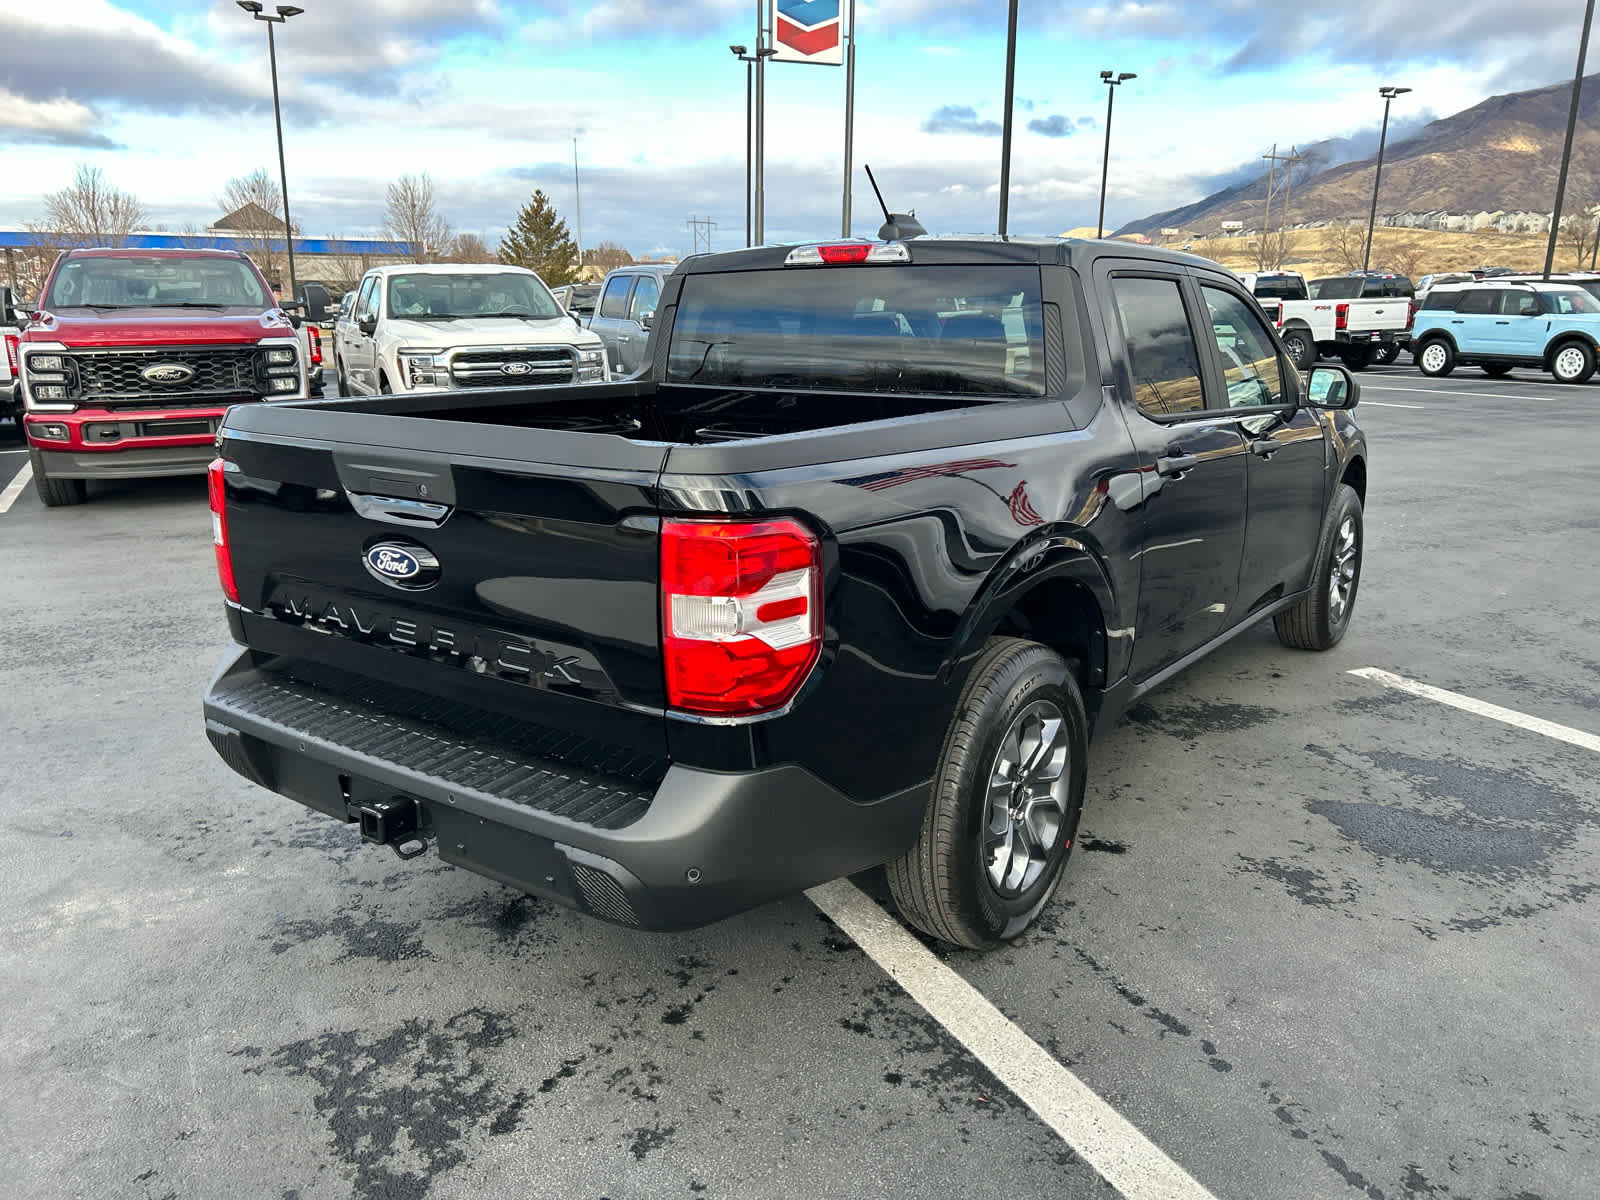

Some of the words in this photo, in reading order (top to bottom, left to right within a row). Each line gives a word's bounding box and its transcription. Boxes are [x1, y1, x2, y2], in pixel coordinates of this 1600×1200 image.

[152, 369, 182, 380] Ford
[508, 364, 526, 373] Ford
[376, 550, 409, 574] Ford
[282, 594, 581, 684] MAVERICK
